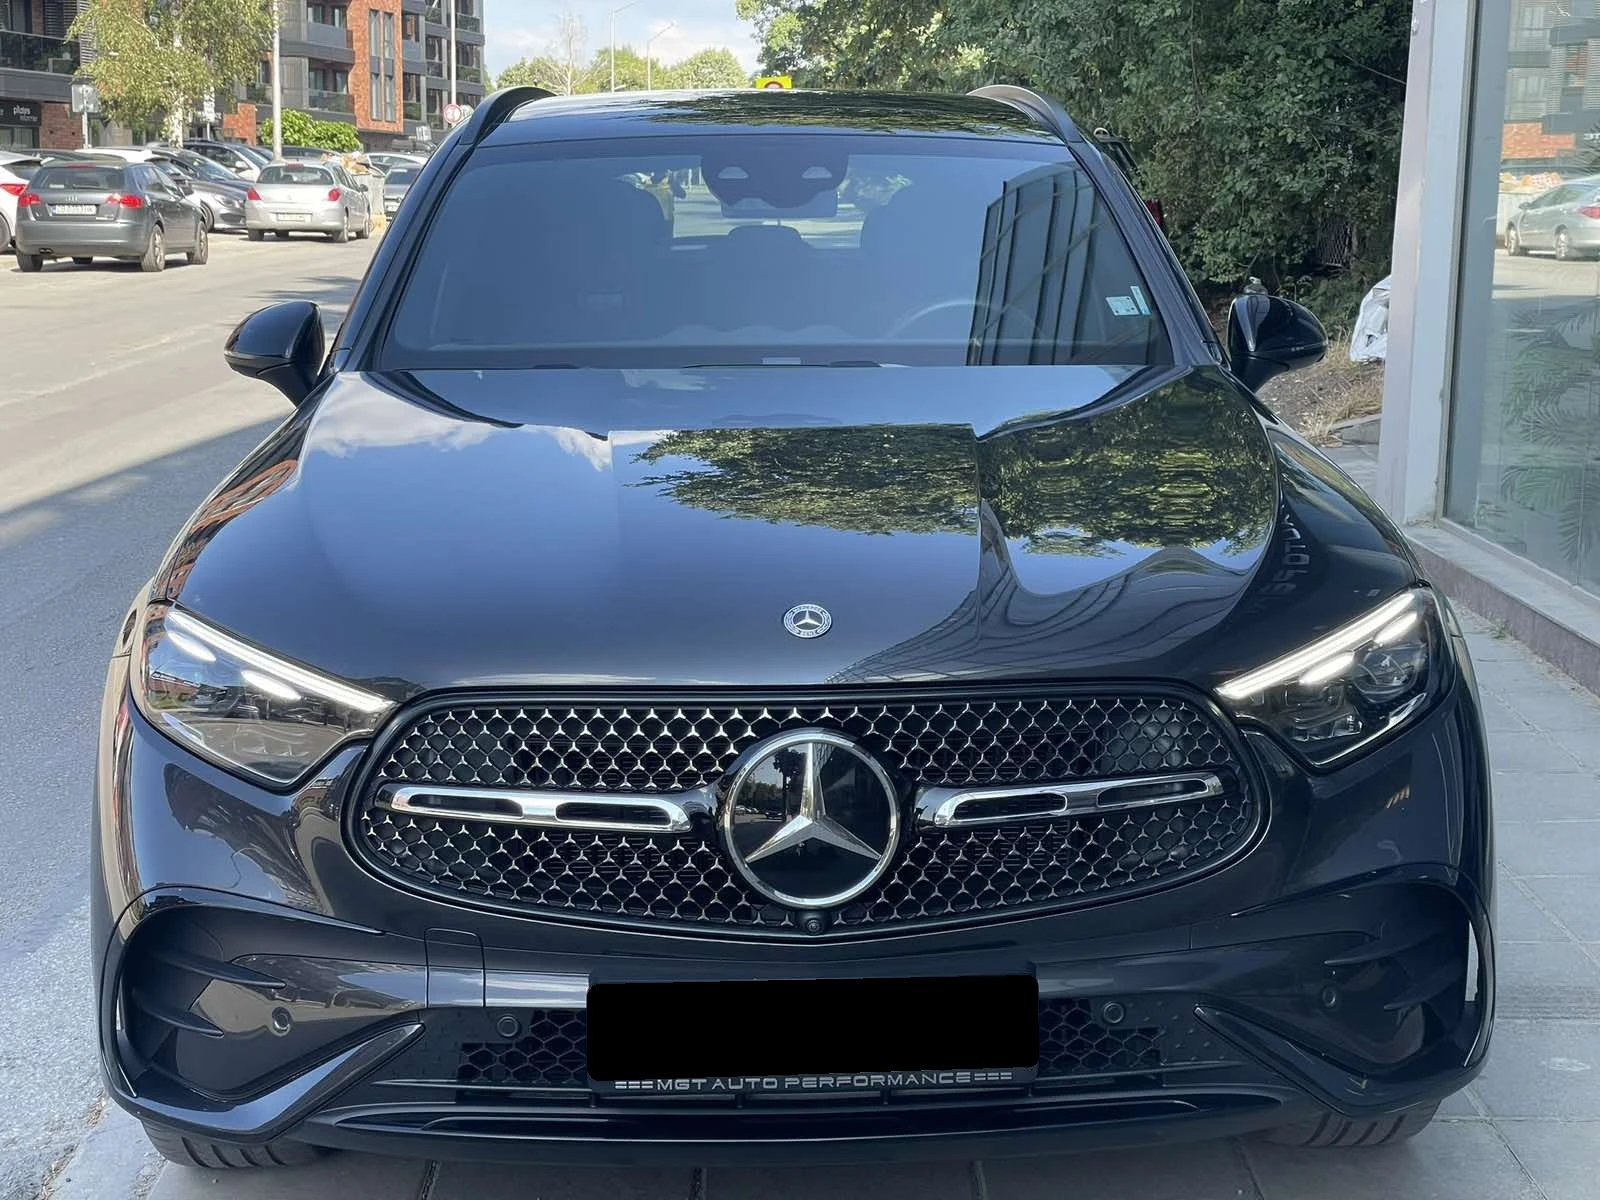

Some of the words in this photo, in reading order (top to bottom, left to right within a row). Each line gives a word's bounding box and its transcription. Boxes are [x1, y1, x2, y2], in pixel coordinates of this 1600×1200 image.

[657, 1078, 707, 1091] MGT
[711, 1077, 778, 1090] AUTO
[784, 1071, 971, 1089] PERFORMANCE
